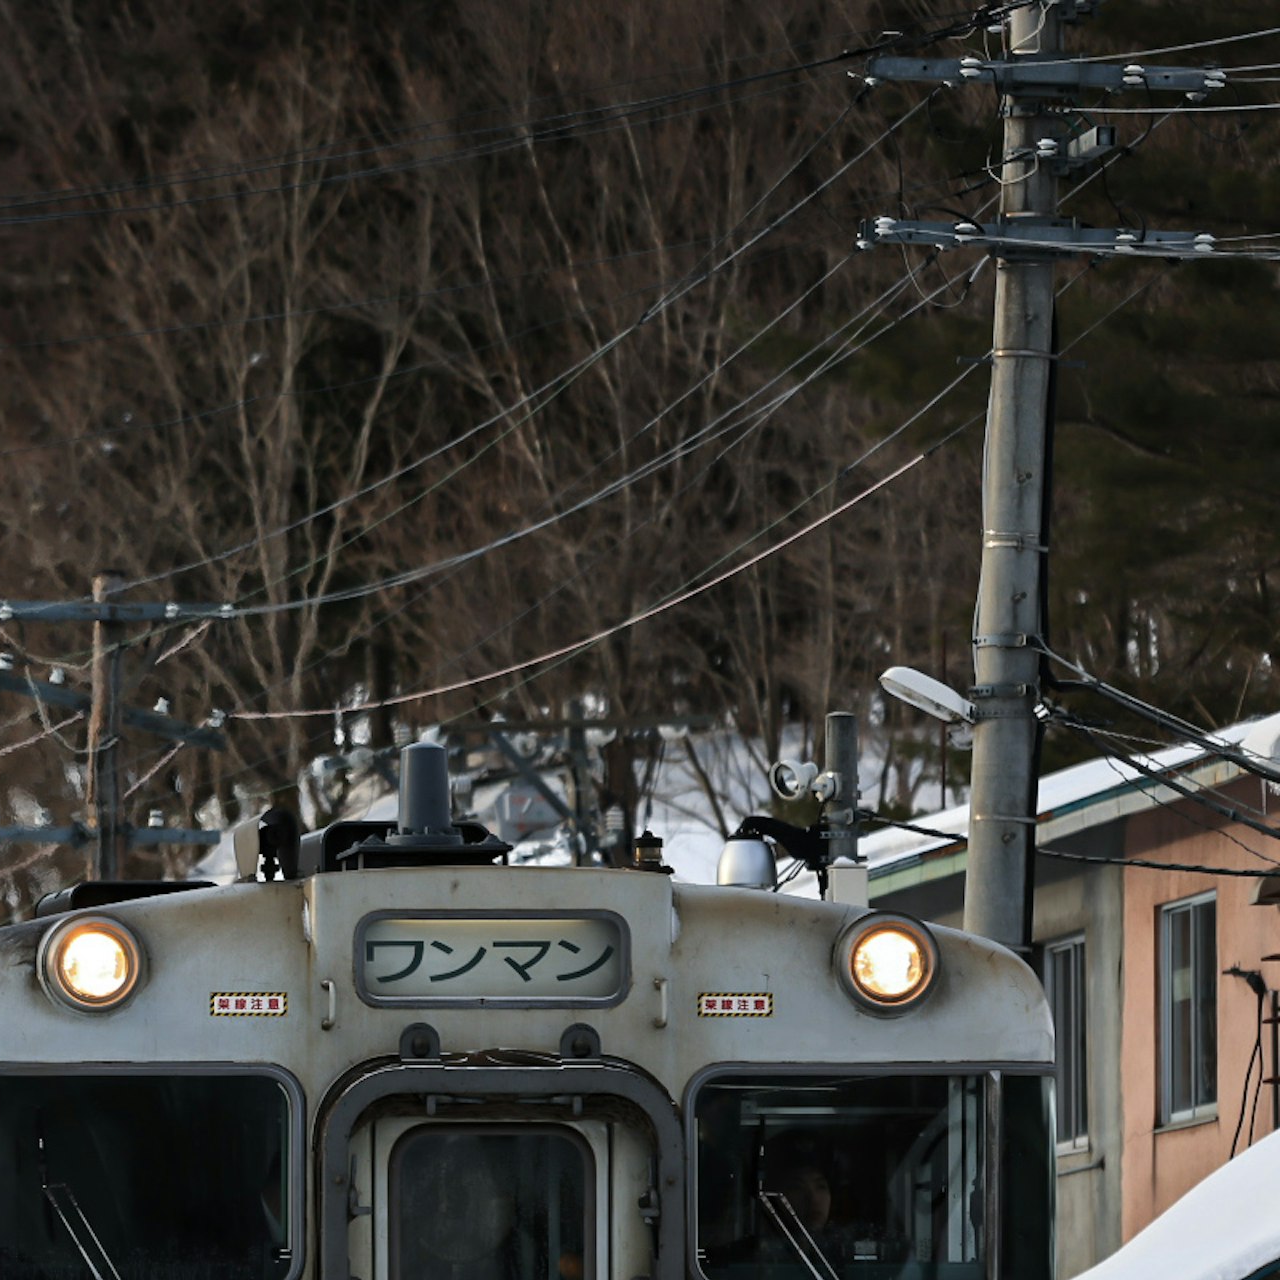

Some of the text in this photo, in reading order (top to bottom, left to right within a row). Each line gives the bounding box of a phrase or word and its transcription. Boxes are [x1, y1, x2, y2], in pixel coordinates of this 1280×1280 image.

[366, 940, 614, 983] ワンマン
[218, 998, 280, 1010] 架線注意
[705, 999, 766, 1010] 架線注意
